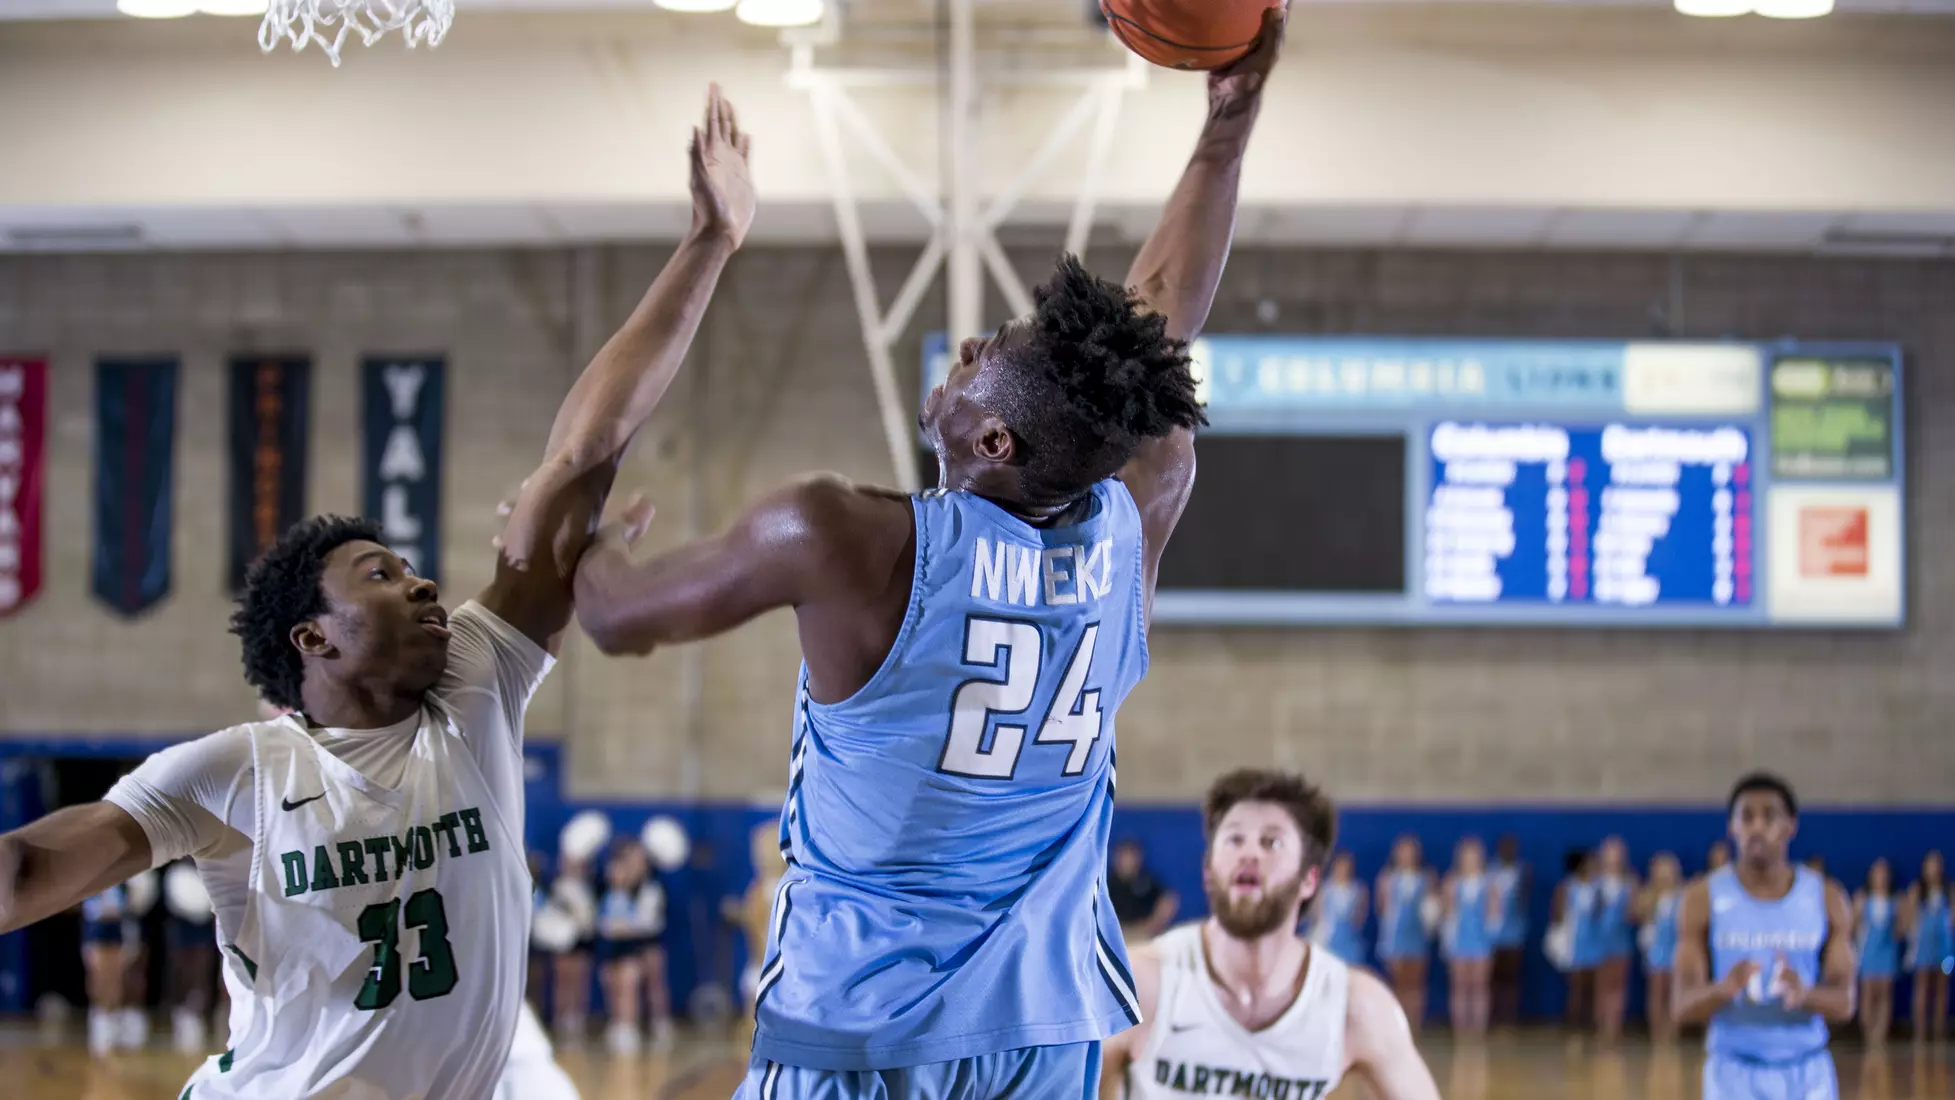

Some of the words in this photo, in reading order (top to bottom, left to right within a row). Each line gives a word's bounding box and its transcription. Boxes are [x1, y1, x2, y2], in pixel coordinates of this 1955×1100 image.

[938, 613, 1103, 780] 24
[281, 807, 490, 897] DARTMOTH
[354, 888, 459, 1011] 33
